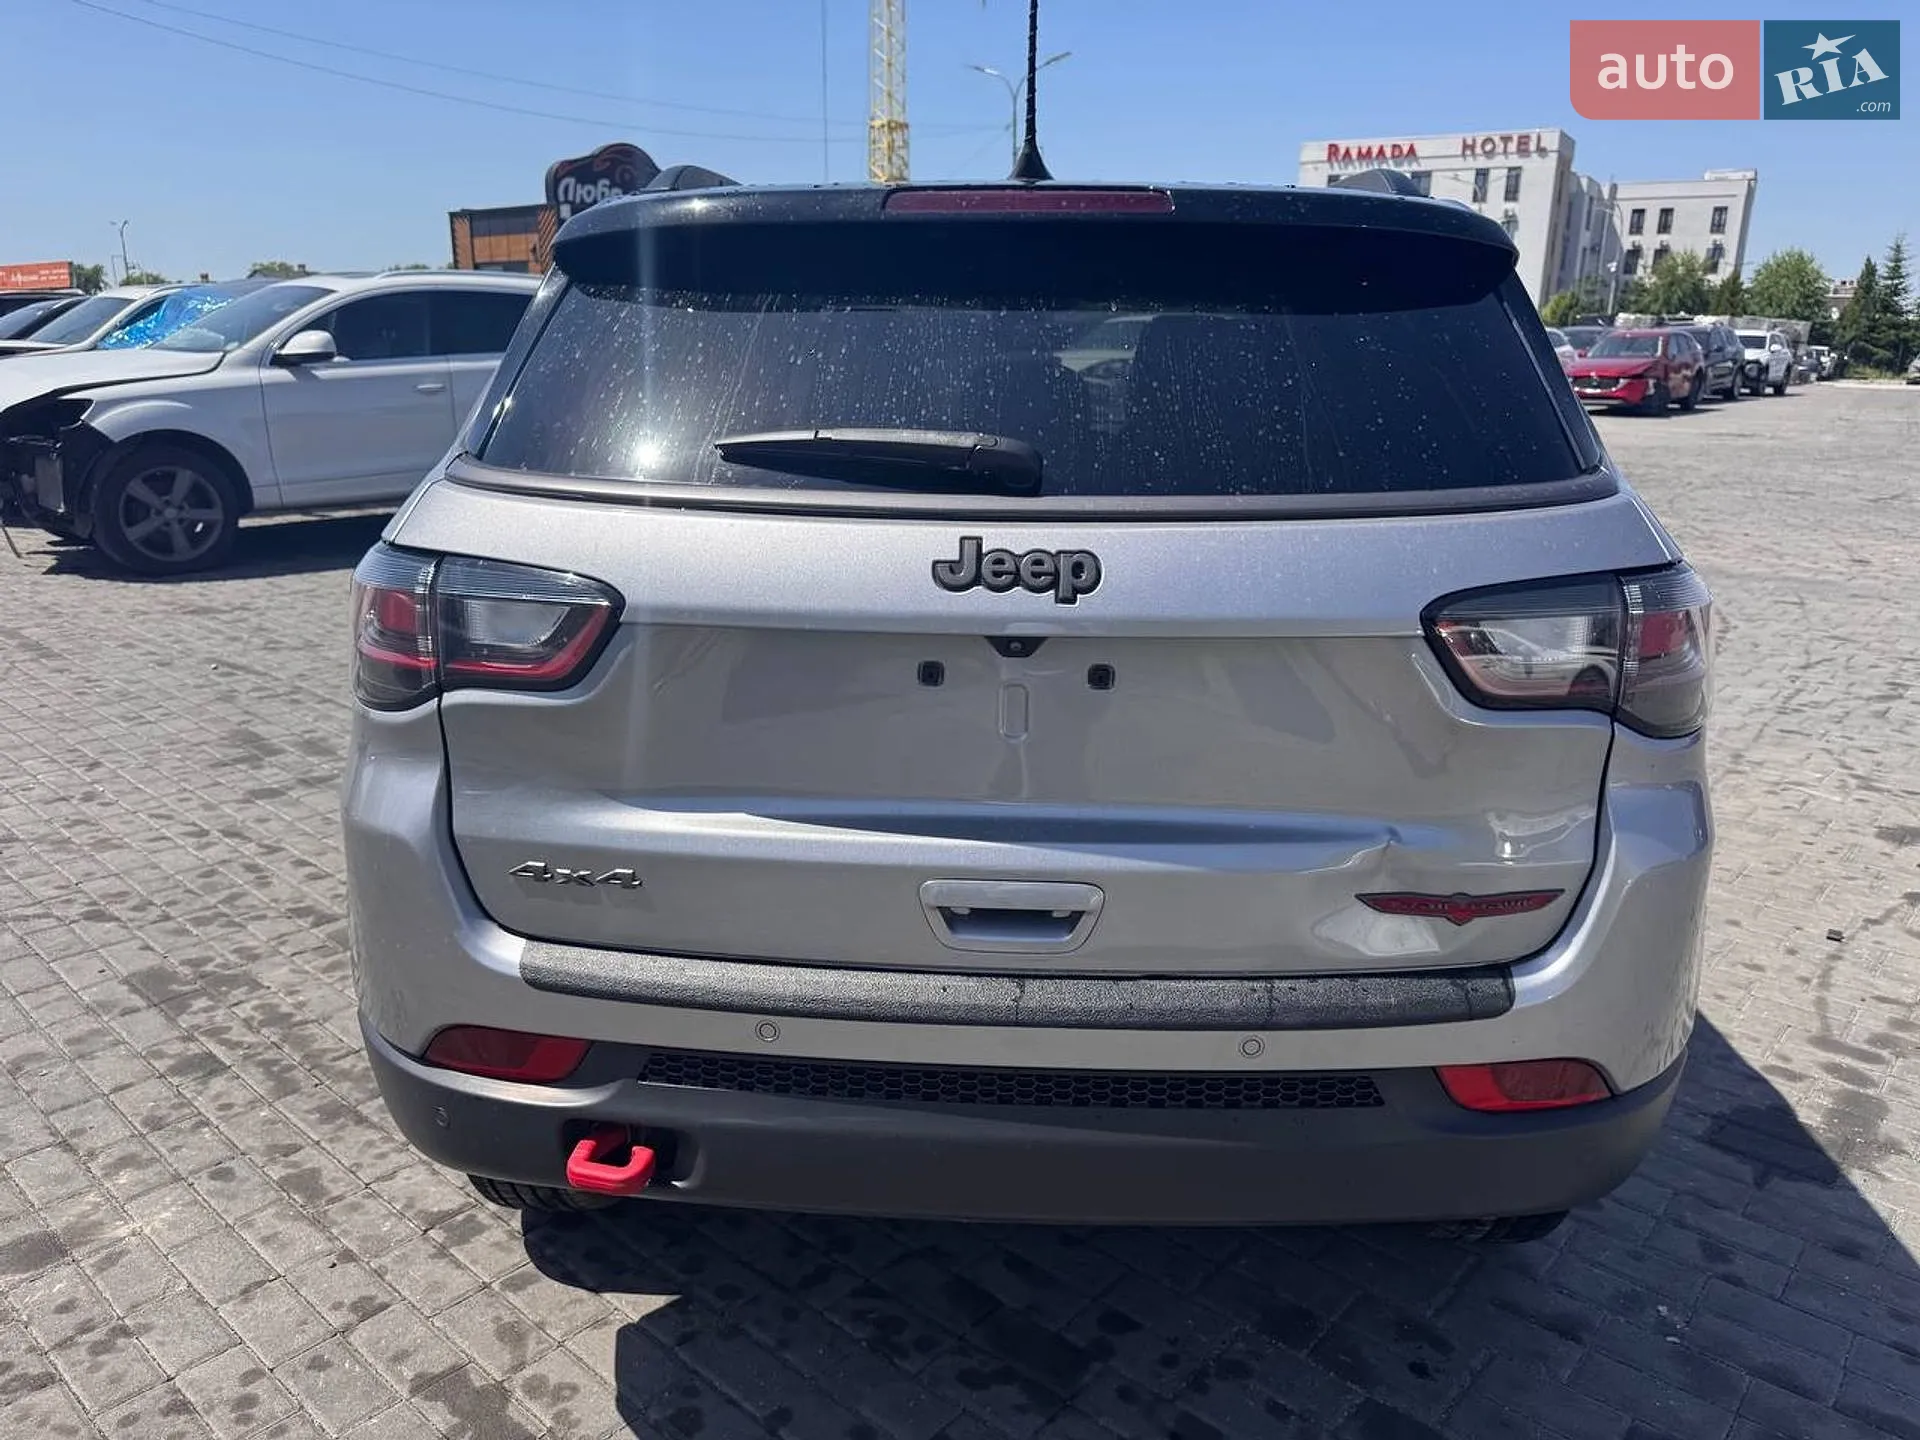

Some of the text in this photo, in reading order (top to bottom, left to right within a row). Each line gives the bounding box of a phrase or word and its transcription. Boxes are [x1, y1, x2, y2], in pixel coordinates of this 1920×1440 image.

[1326, 132, 1549, 164] RAMADA HOTEL
[932, 536, 1101, 604] Jeep
